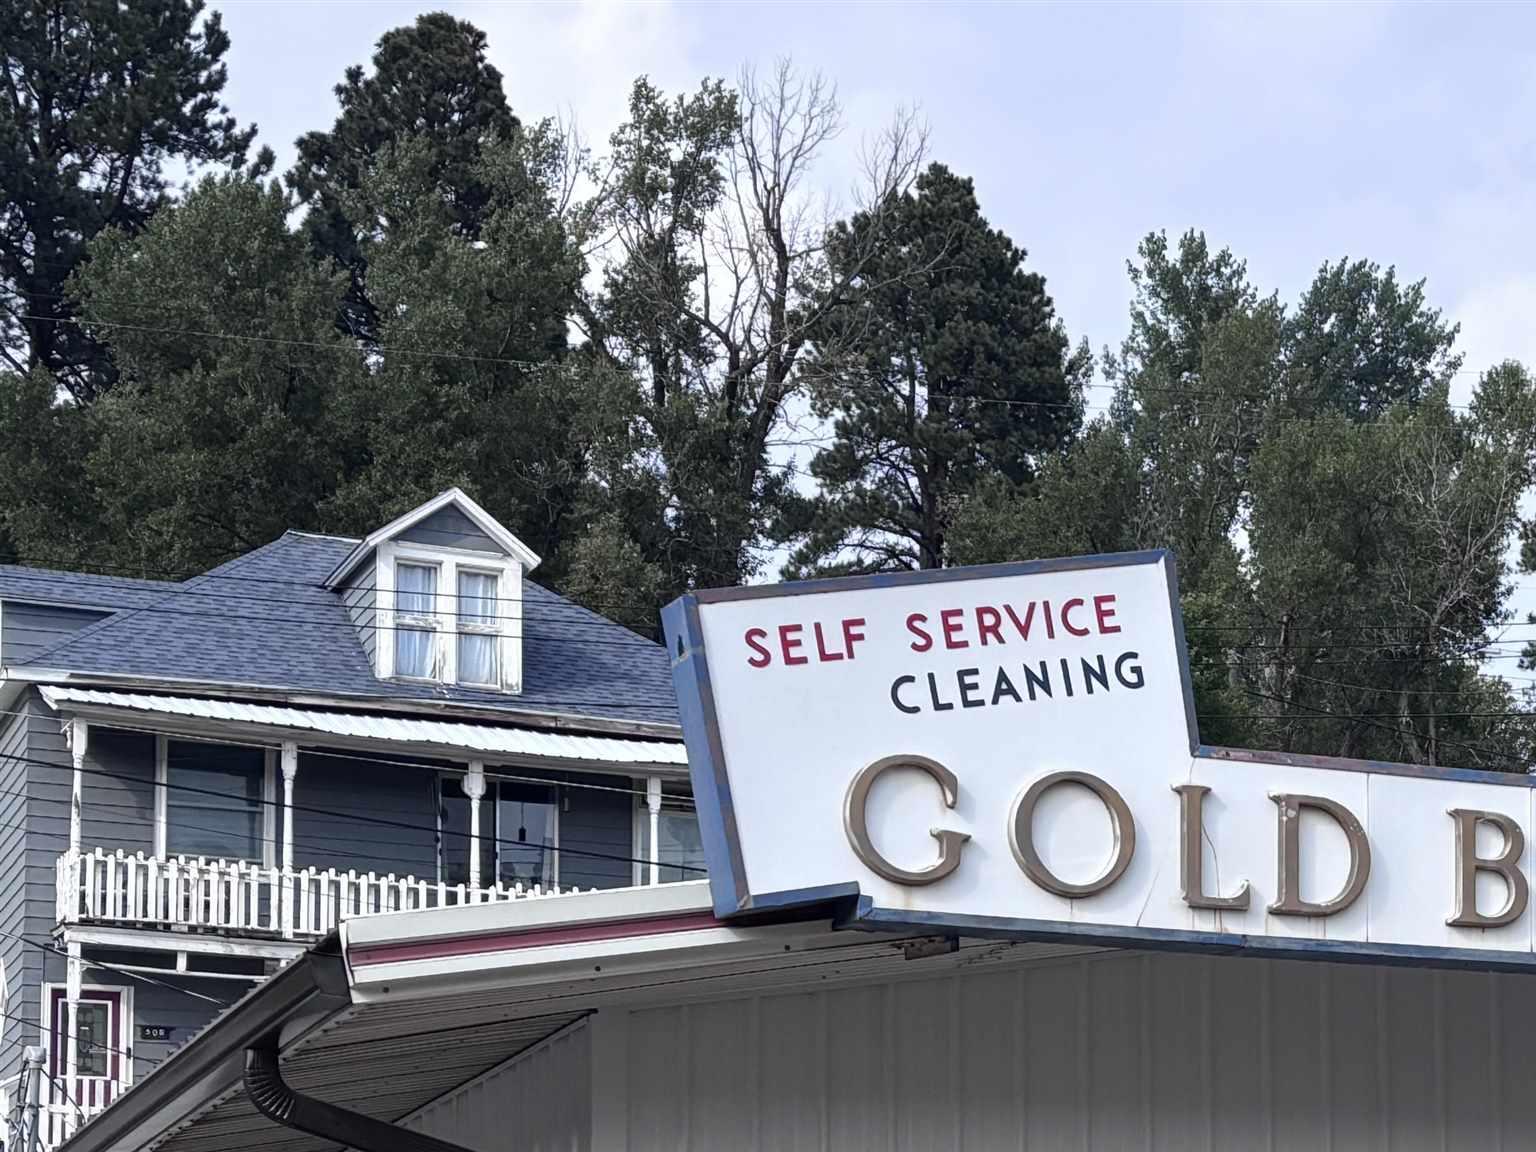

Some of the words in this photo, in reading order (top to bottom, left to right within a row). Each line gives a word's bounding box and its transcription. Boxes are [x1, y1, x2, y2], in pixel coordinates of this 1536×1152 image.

[744, 617, 867, 669] SELF
[905, 594, 1123, 653] SERVICE
[890, 651, 1146, 715] CLEANING
[842, 753, 1372, 934] GOLD
